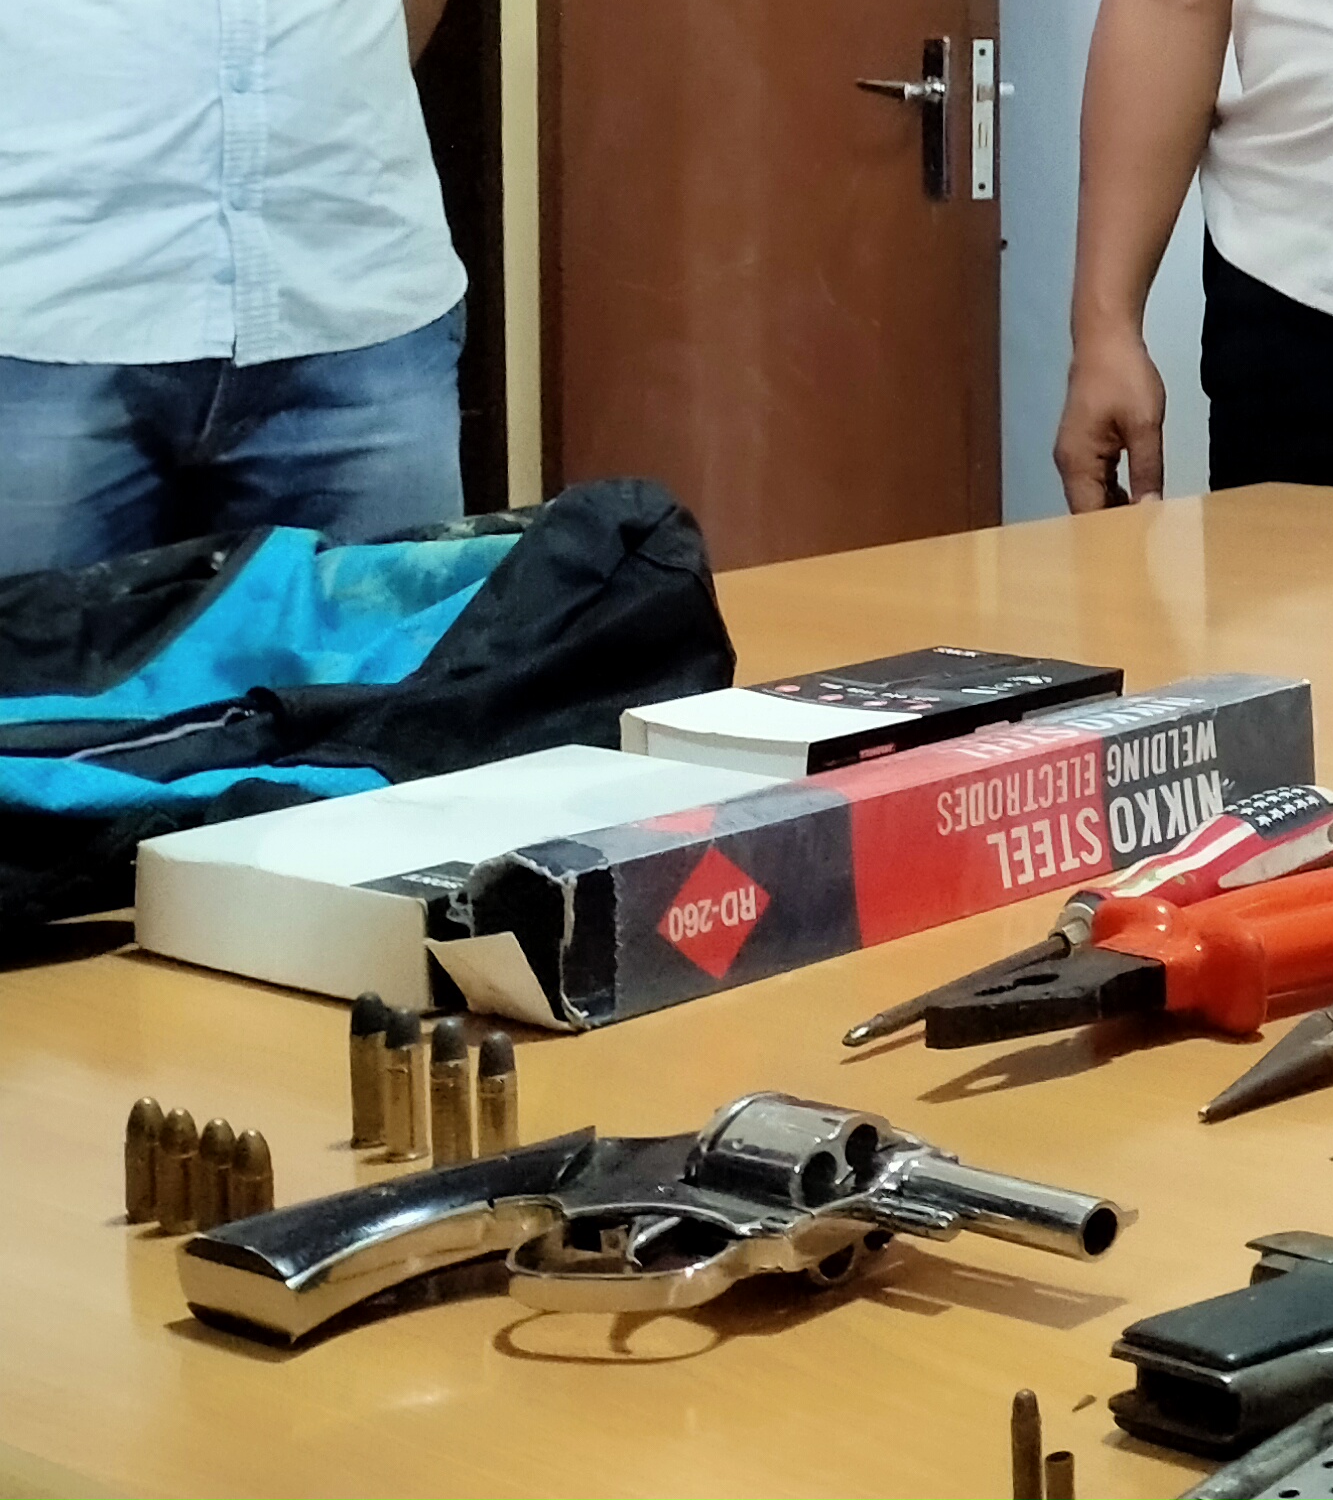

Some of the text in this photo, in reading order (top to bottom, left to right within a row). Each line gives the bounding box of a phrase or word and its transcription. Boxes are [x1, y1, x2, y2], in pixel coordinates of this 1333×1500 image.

[936, 719, 1217, 836] WELDING ELECTRODES
[986, 768, 1224, 890] NIKKO STEEL
[667, 884, 757, 942] RD-260
